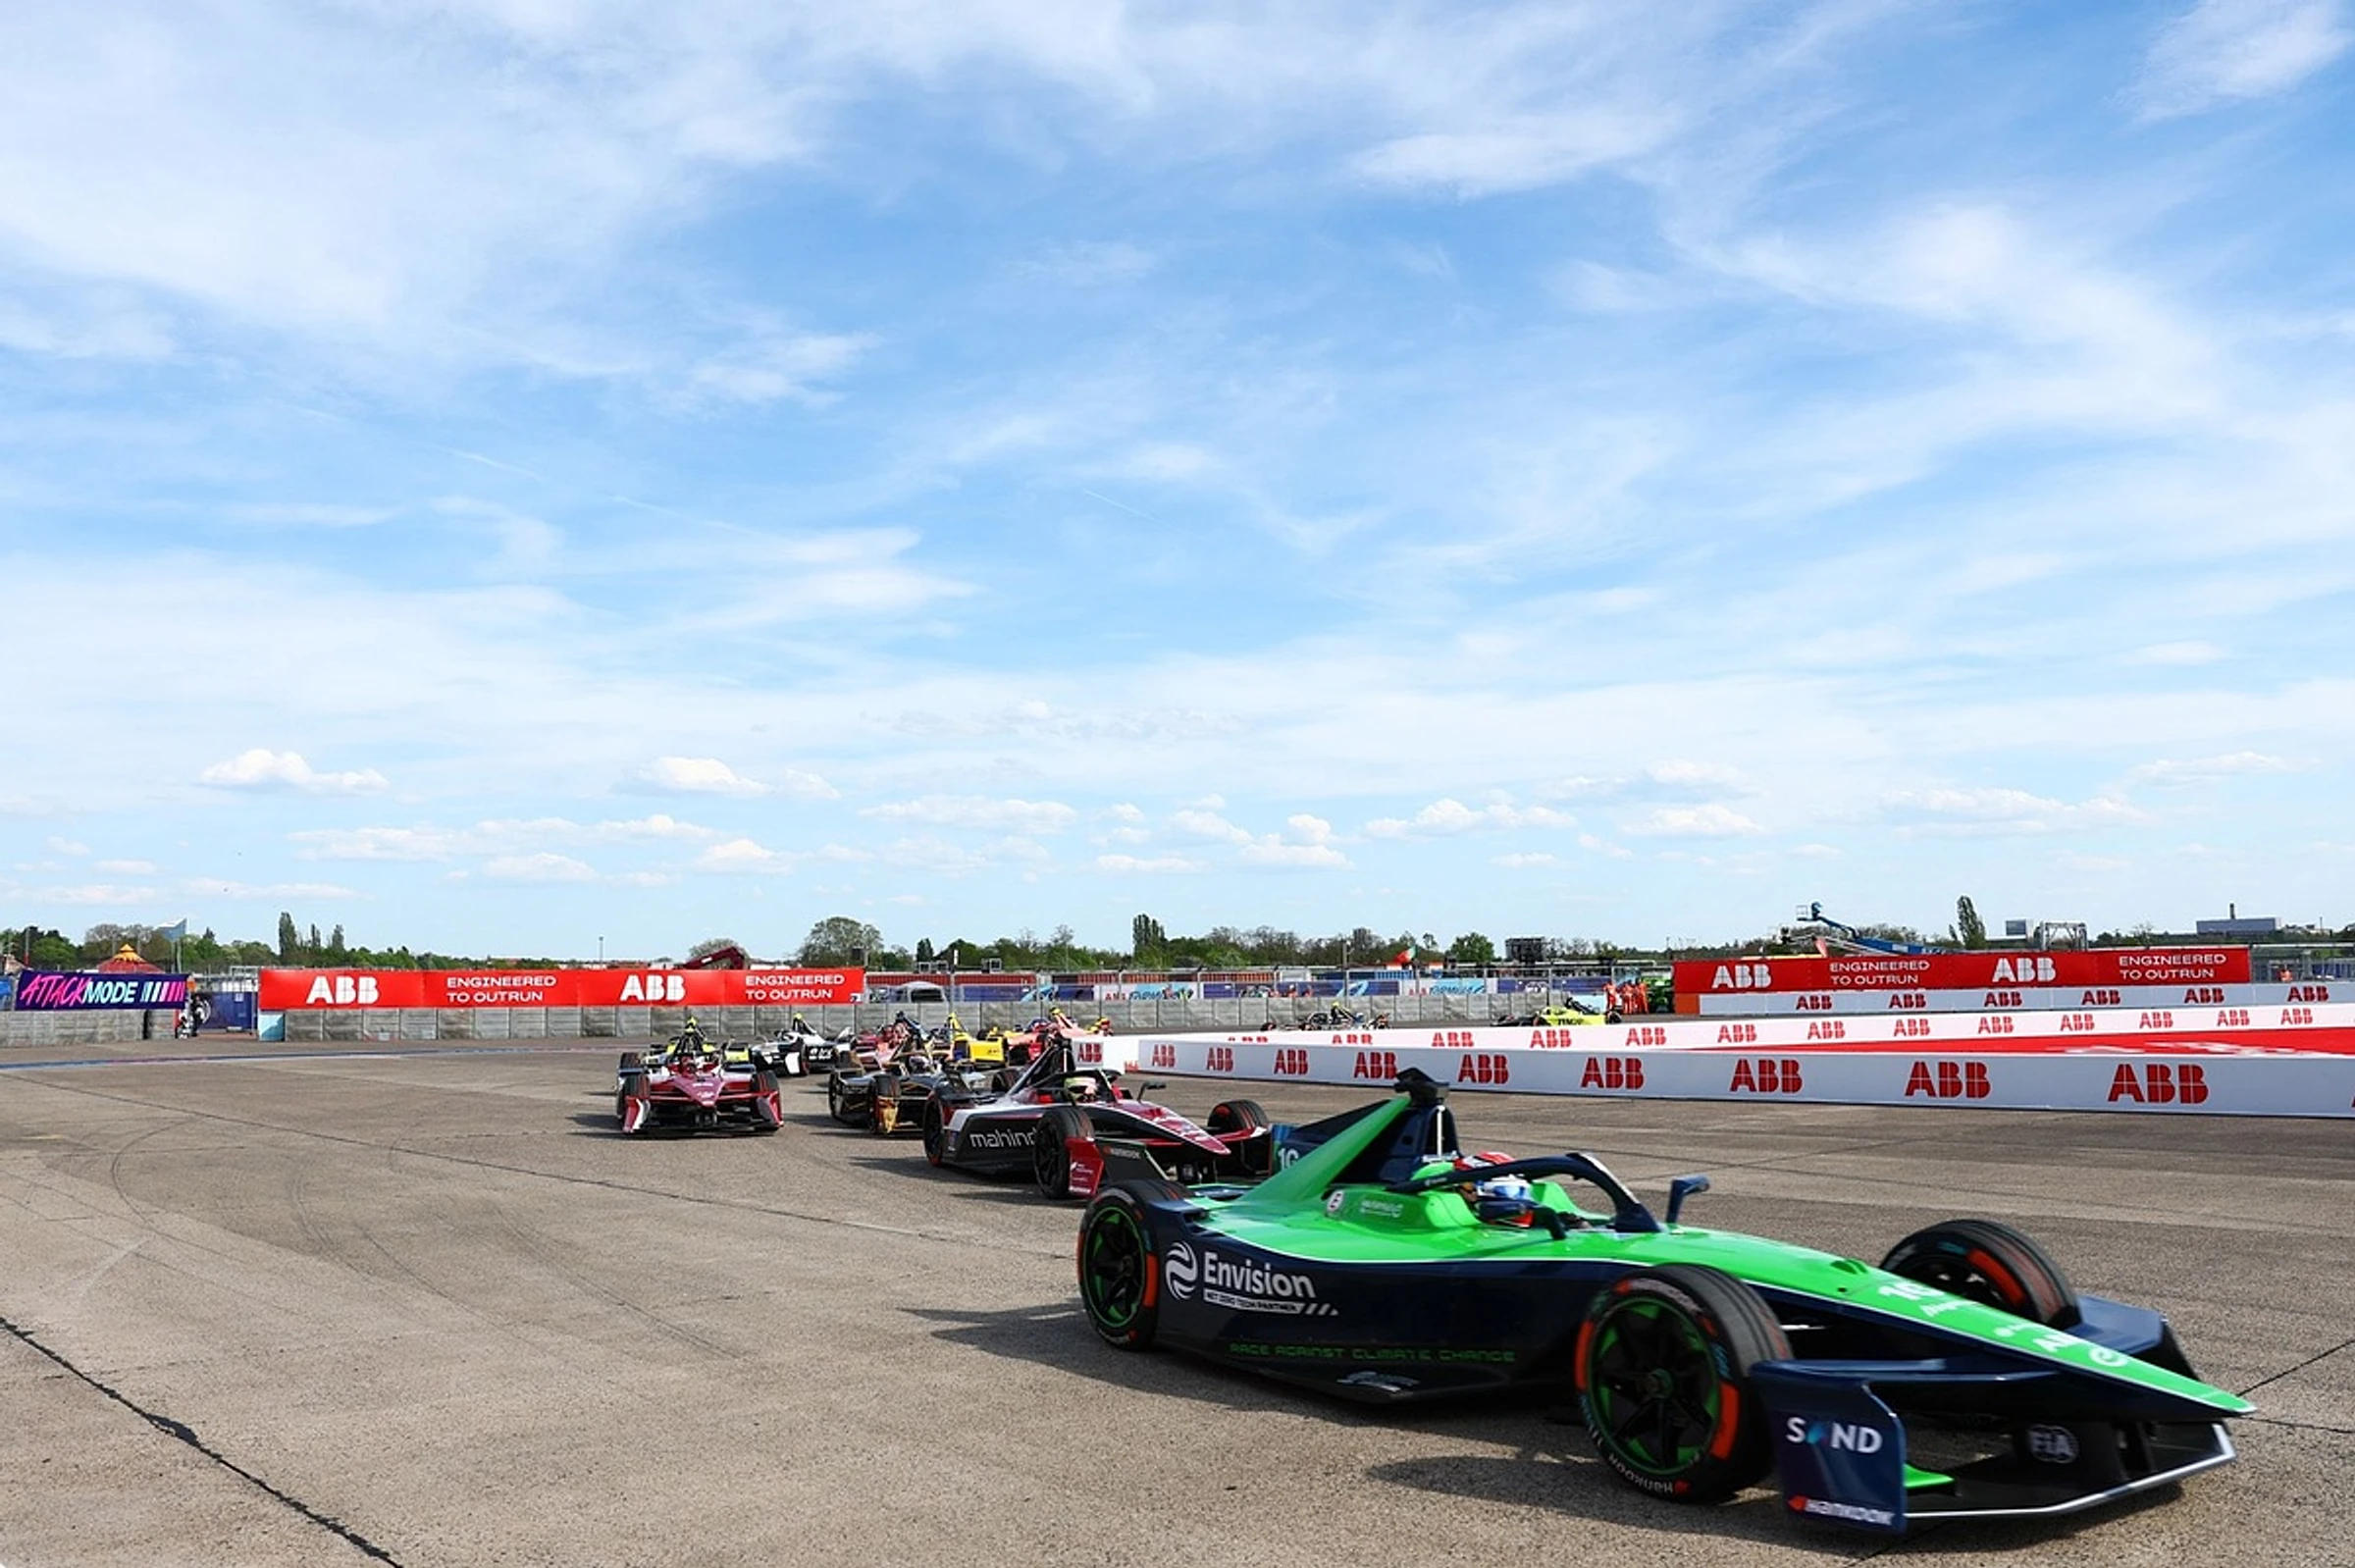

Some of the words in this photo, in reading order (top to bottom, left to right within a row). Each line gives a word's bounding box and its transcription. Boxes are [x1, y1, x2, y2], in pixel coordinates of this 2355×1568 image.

[1830, 961, 1930, 972] ENGINEERED
[2119, 954, 2226, 966] ENGINEERED
[1711, 964, 1772, 989] ABB
[1992, 958, 2057, 982] ABB
[2120, 969, 2142, 980] TO
[2146, 968, 2214, 979] OUTRUN
[446, 975, 556, 987] ENGINEERED
[620, 974, 686, 1001] ABB
[745, 973, 845, 986] ENGINEERED
[1832, 975, 1852, 986] TO
[1855, 974, 1918, 985] OUTRUN
[305, 975, 379, 1004] ABB
[447, 992, 469, 1003] TO
[473, 991, 543, 1002] OUTRUN
[746, 989, 766, 1000] TO
[770, 988, 832, 1000] OUTRUN
[2082, 990, 2120, 1005] ABB
[2185, 988, 2224, 1003] ABB
[2288, 986, 2329, 1002] ABB
[1798, 996, 1832, 1010] ABB
[1890, 994, 1926, 1008] ABB
[1985, 993, 2022, 1007] ABB
[1978, 1016, 2015, 1034] ABB
[2060, 1014, 2095, 1031] ABB
[2139, 1012, 2173, 1029] ABB
[2217, 1010, 2250, 1027] ABB
[2280, 1008, 2313, 1025] ABB
[1625, 1027, 1667, 1046] ABB
[1717, 1023, 1757, 1043] ABB
[1807, 1020, 1846, 1040] ABB
[1894, 1019, 1931, 1037] ABB
[1530, 1029, 1572, 1048] ABB
[1078, 1043, 1102, 1063] ABB
[1152, 1045, 1176, 1068] ABB
[1206, 1047, 1233, 1071] ABB
[1274, 1049, 1308, 1074] ABB
[1353, 1052, 1397, 1079] ABB
[1458, 1054, 1509, 1084] ABB
[1581, 1057, 1645, 1090] ABB
[1730, 1059, 1804, 1093] ABB
[1905, 1061, 1992, 1098] ABB
[2108, 1064, 2209, 1104] ABB
[1204, 1251, 1316, 1298] Envision
[1276, 1344, 1344, 1359] AGAINST
[1352, 1347, 1432, 1361] CLIMATE
